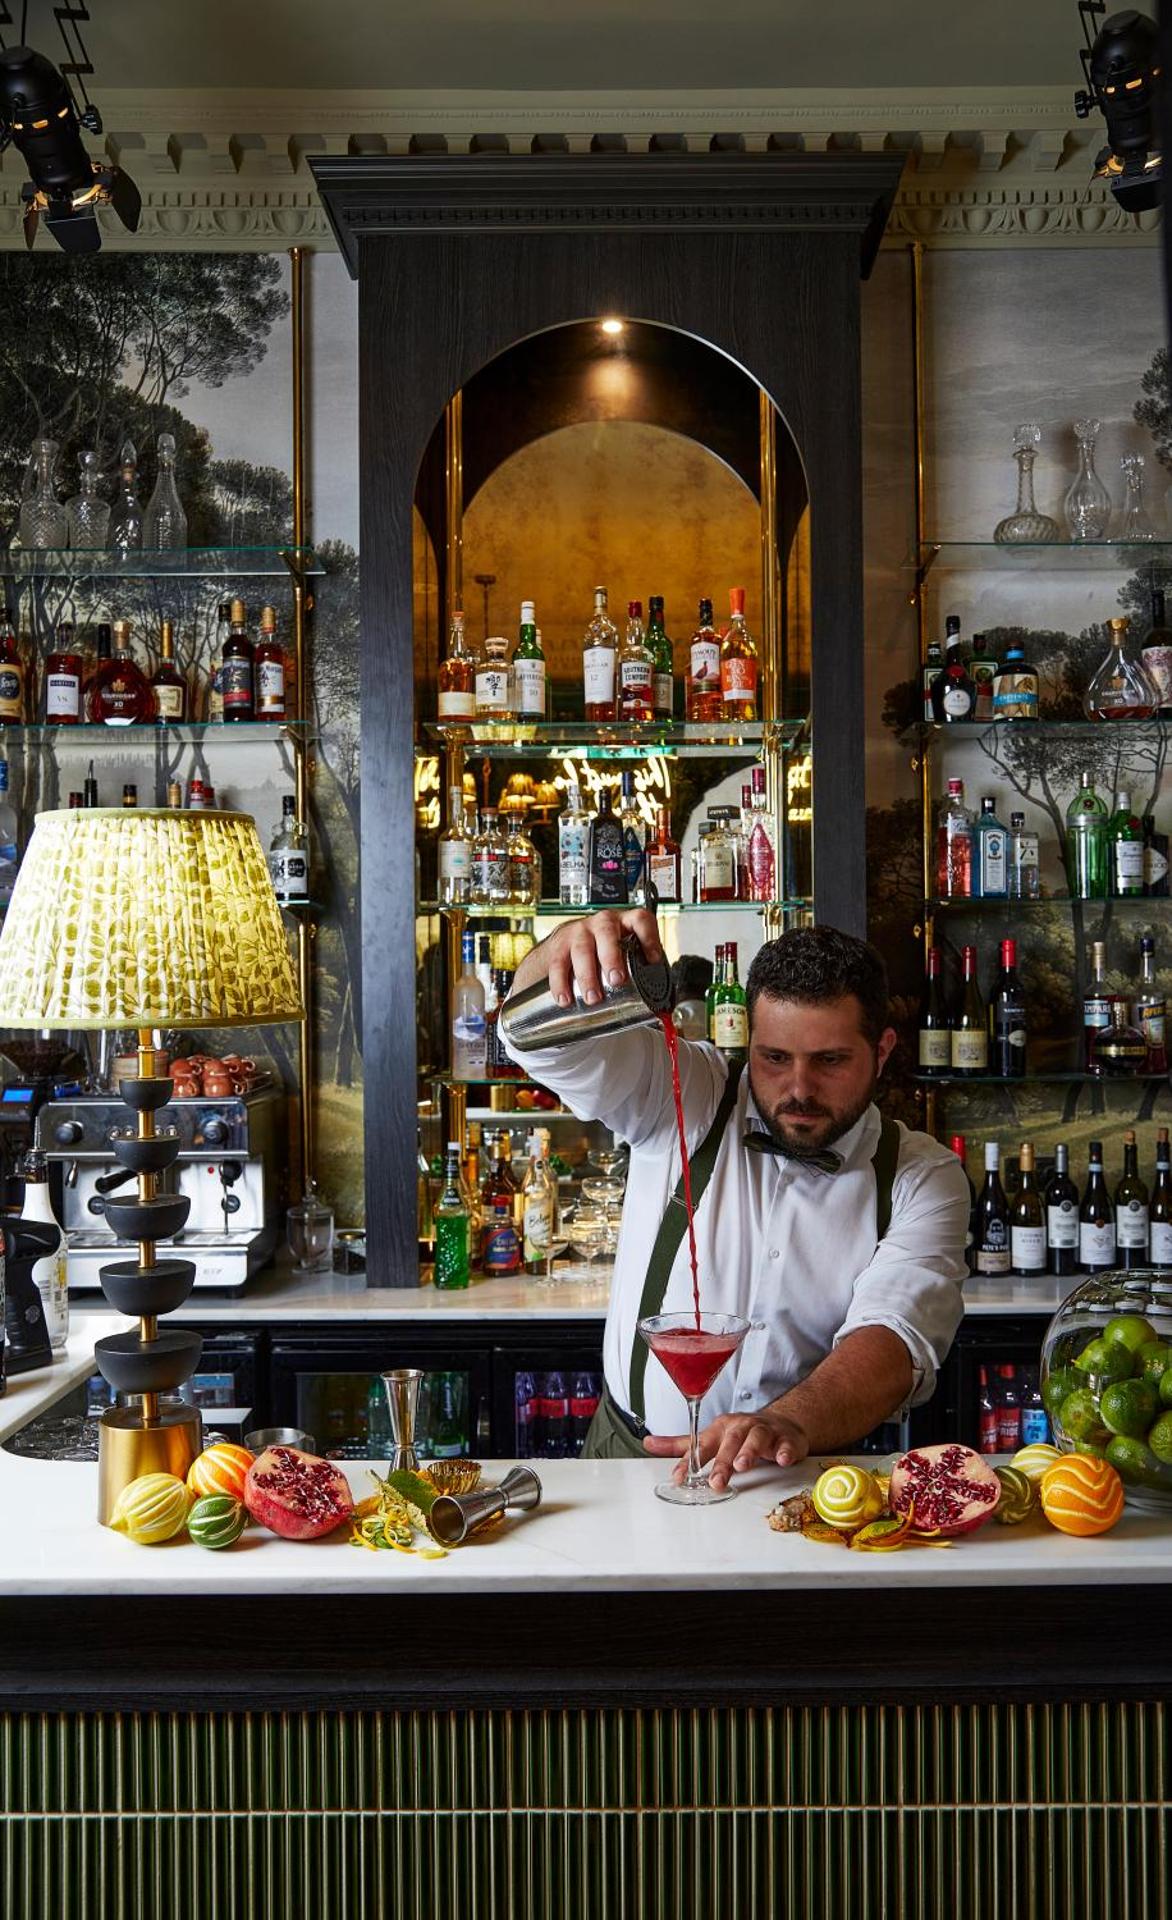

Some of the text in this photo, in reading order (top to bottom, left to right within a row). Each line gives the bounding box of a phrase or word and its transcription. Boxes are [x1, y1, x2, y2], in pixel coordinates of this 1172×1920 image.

[623, 666, 649, 674] SOUTHERN
[597, 847, 623, 859] ROSE
[716, 1006, 747, 1015] JAMESON
